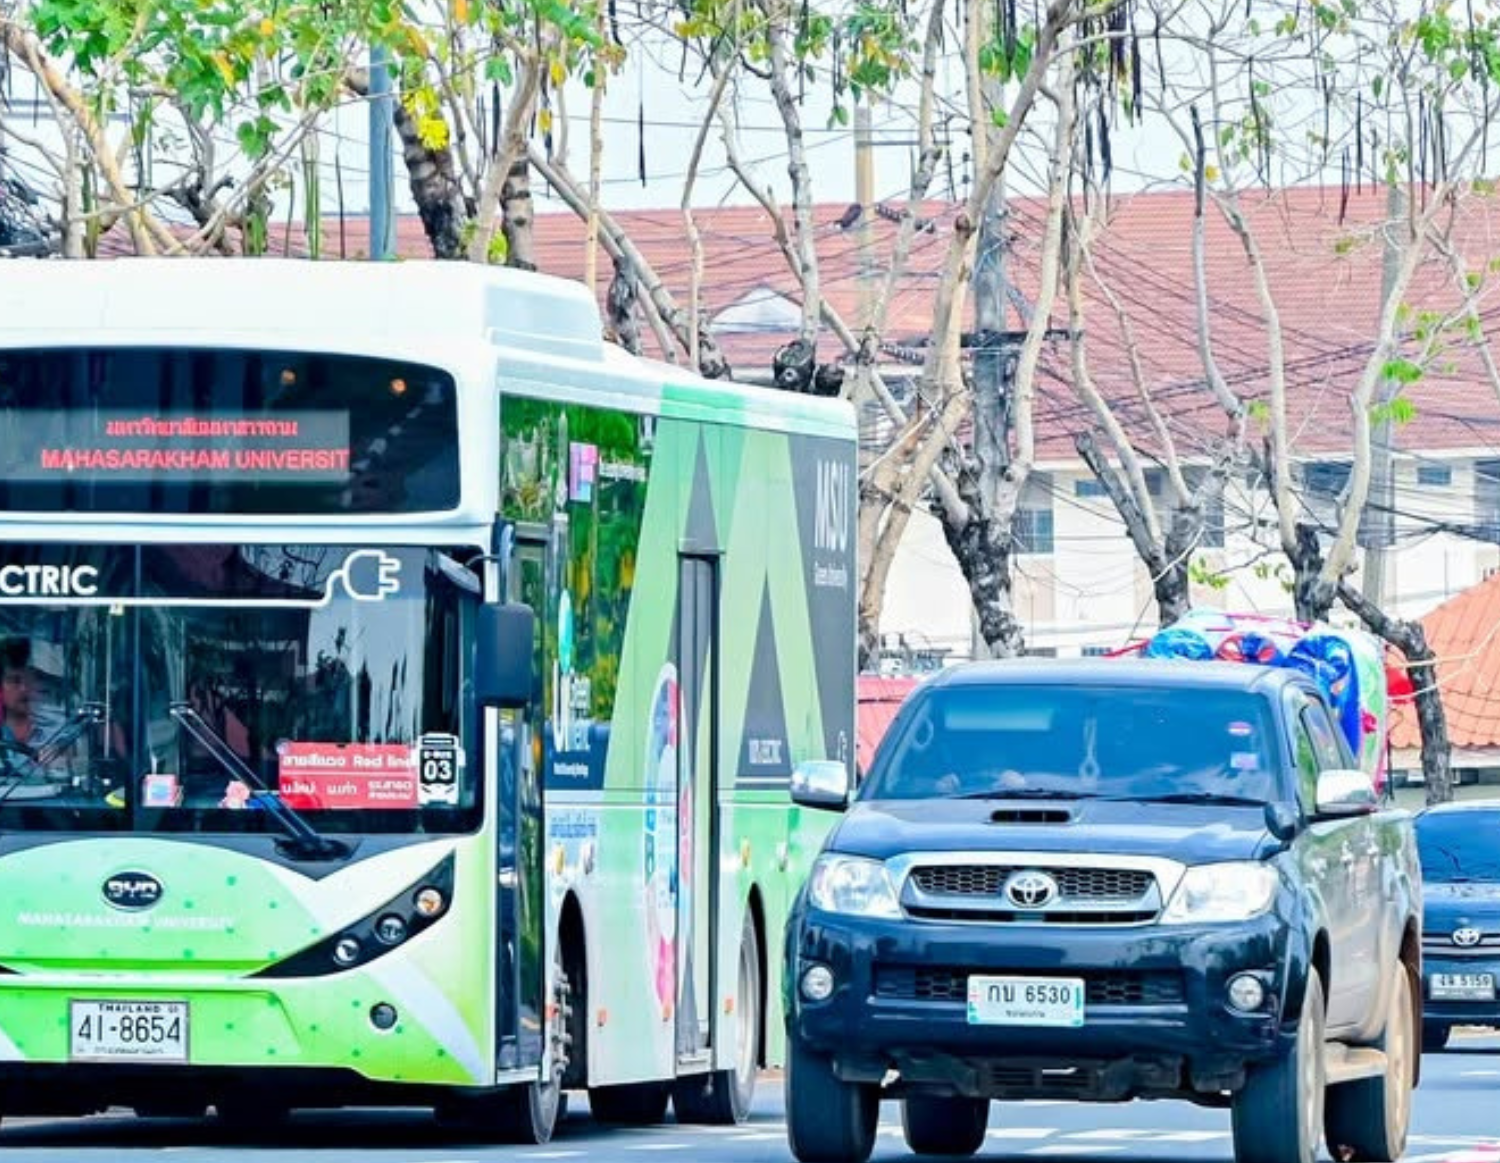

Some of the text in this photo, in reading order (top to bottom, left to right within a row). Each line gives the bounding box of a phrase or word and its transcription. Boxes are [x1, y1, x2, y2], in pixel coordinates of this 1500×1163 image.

[41, 448, 350, 470] MAHASARAKHAM UNIVERSIT
[353, 754, 383, 768] Red
[423, 760, 453, 781] 03
[1026, 984, 1071, 1004] 6530
[99, 1002, 161, 1014] THAILAND
[78, 1014, 181, 1043] 41-8654
